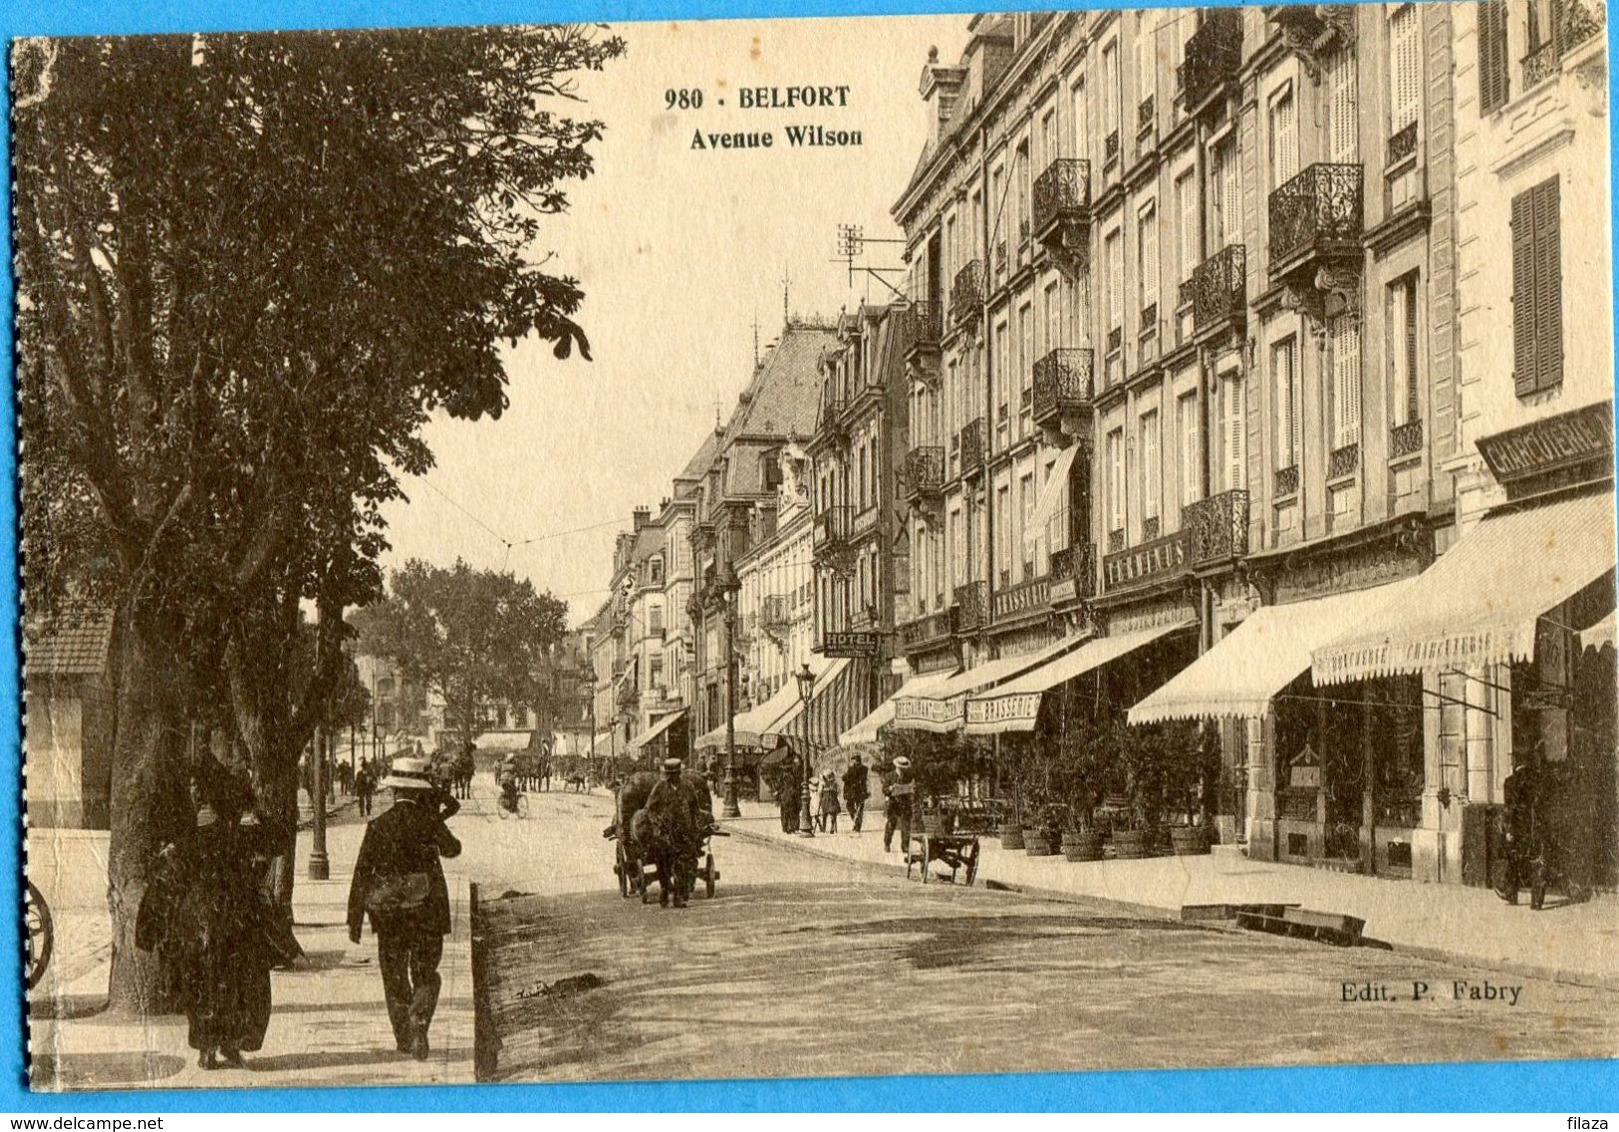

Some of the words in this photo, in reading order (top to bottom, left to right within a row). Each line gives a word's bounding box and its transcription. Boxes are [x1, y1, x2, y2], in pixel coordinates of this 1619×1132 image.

[1108, 540, 1184, 585] TERMINUS
[826, 634, 875, 645] HOTEL
[985, 696, 1033, 721] BRASSERIE
